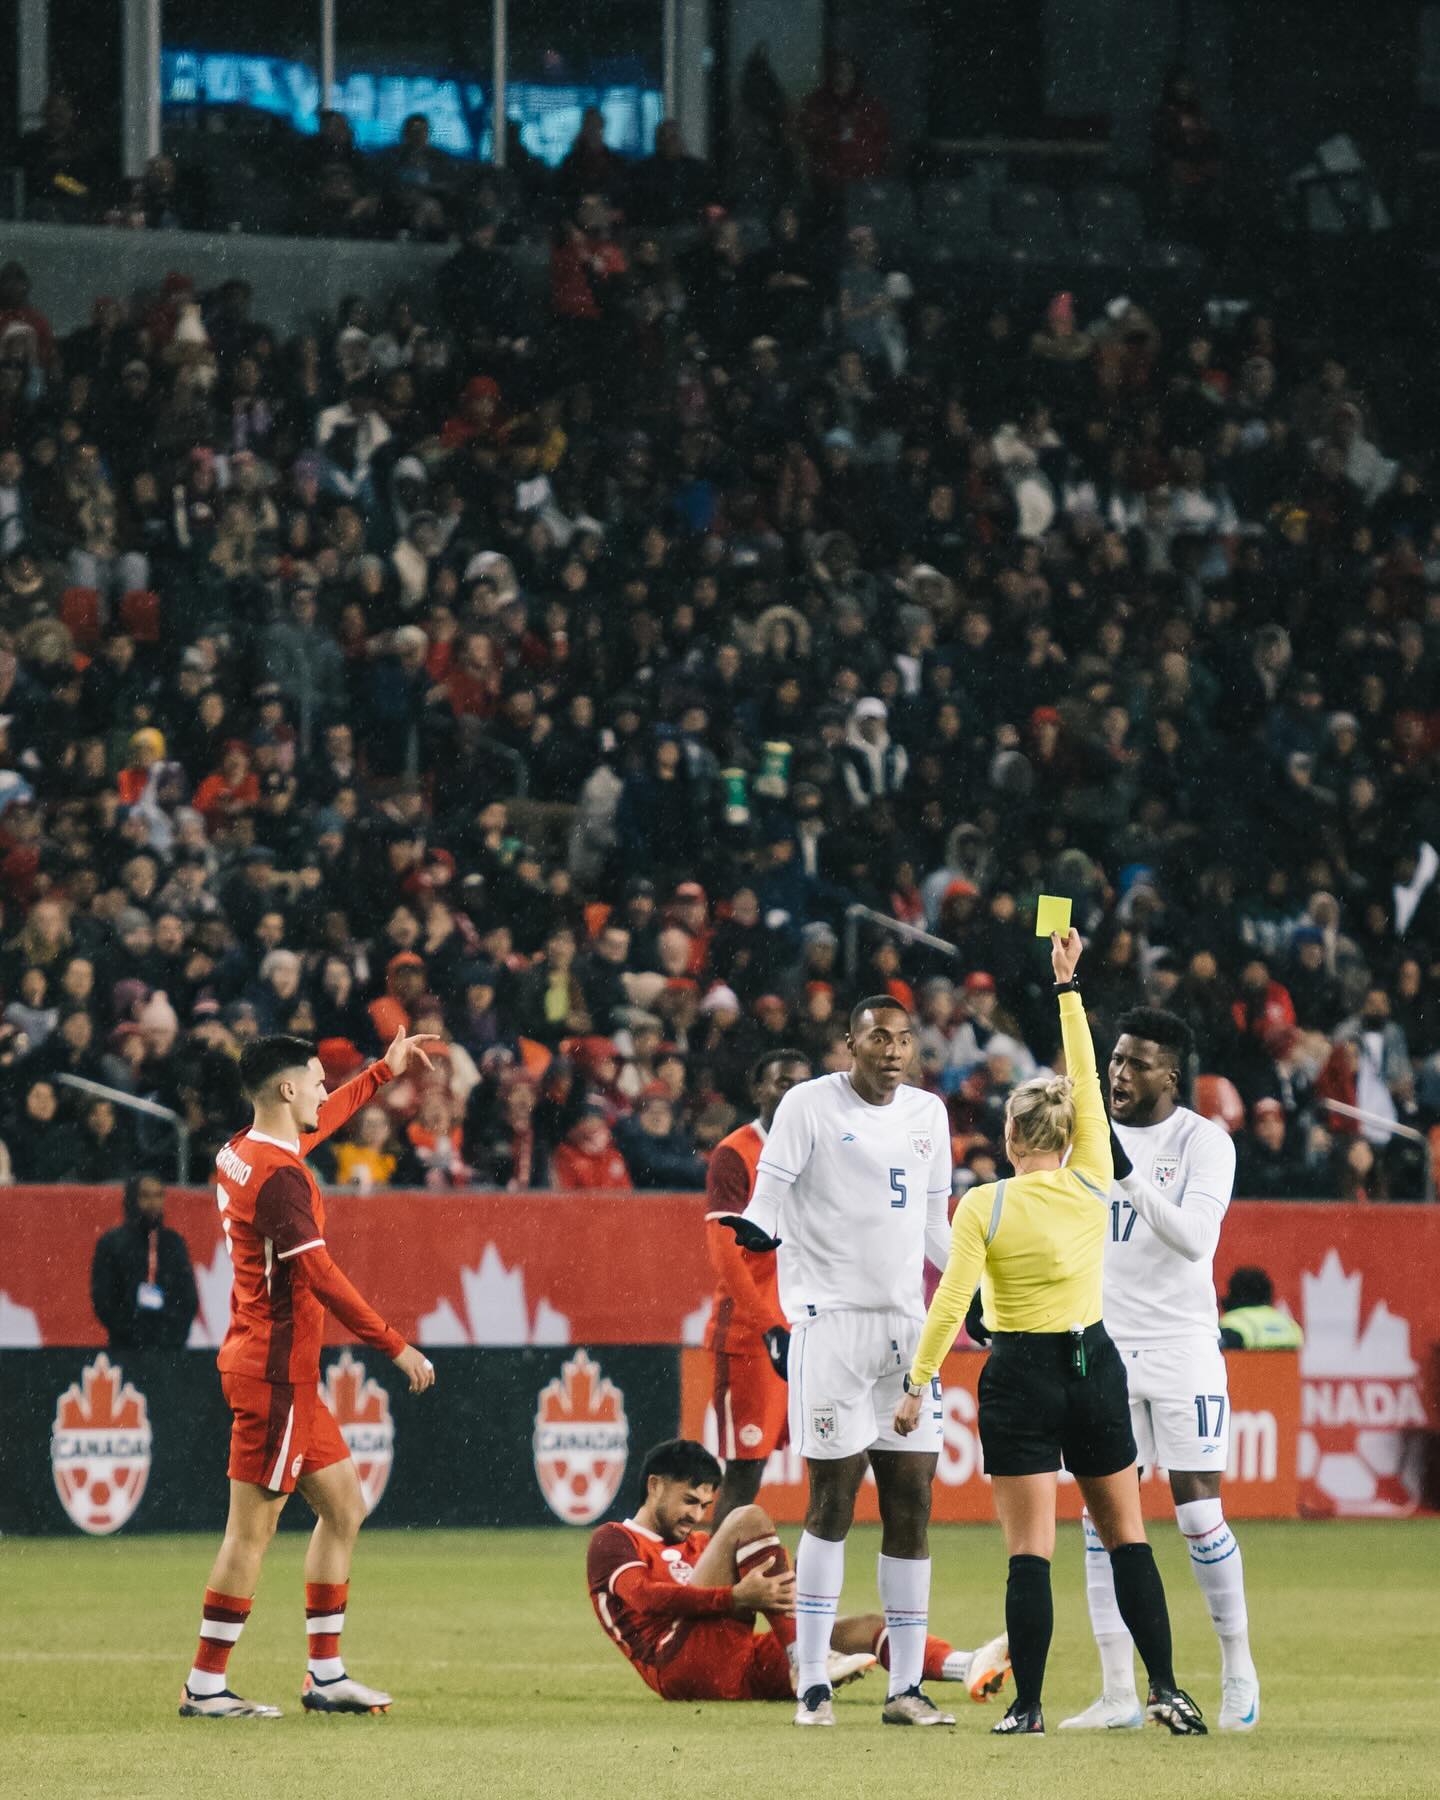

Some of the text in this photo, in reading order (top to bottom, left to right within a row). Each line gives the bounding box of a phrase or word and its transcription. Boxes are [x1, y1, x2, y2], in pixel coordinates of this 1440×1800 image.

[889, 1167, 907, 1209] 5
[1110, 1200, 1138, 1242] 17
[1194, 1394, 1225, 1438] 17
[1301, 1381, 1428, 1426] NADA
[57, 1437, 146, 1458] CANADA
